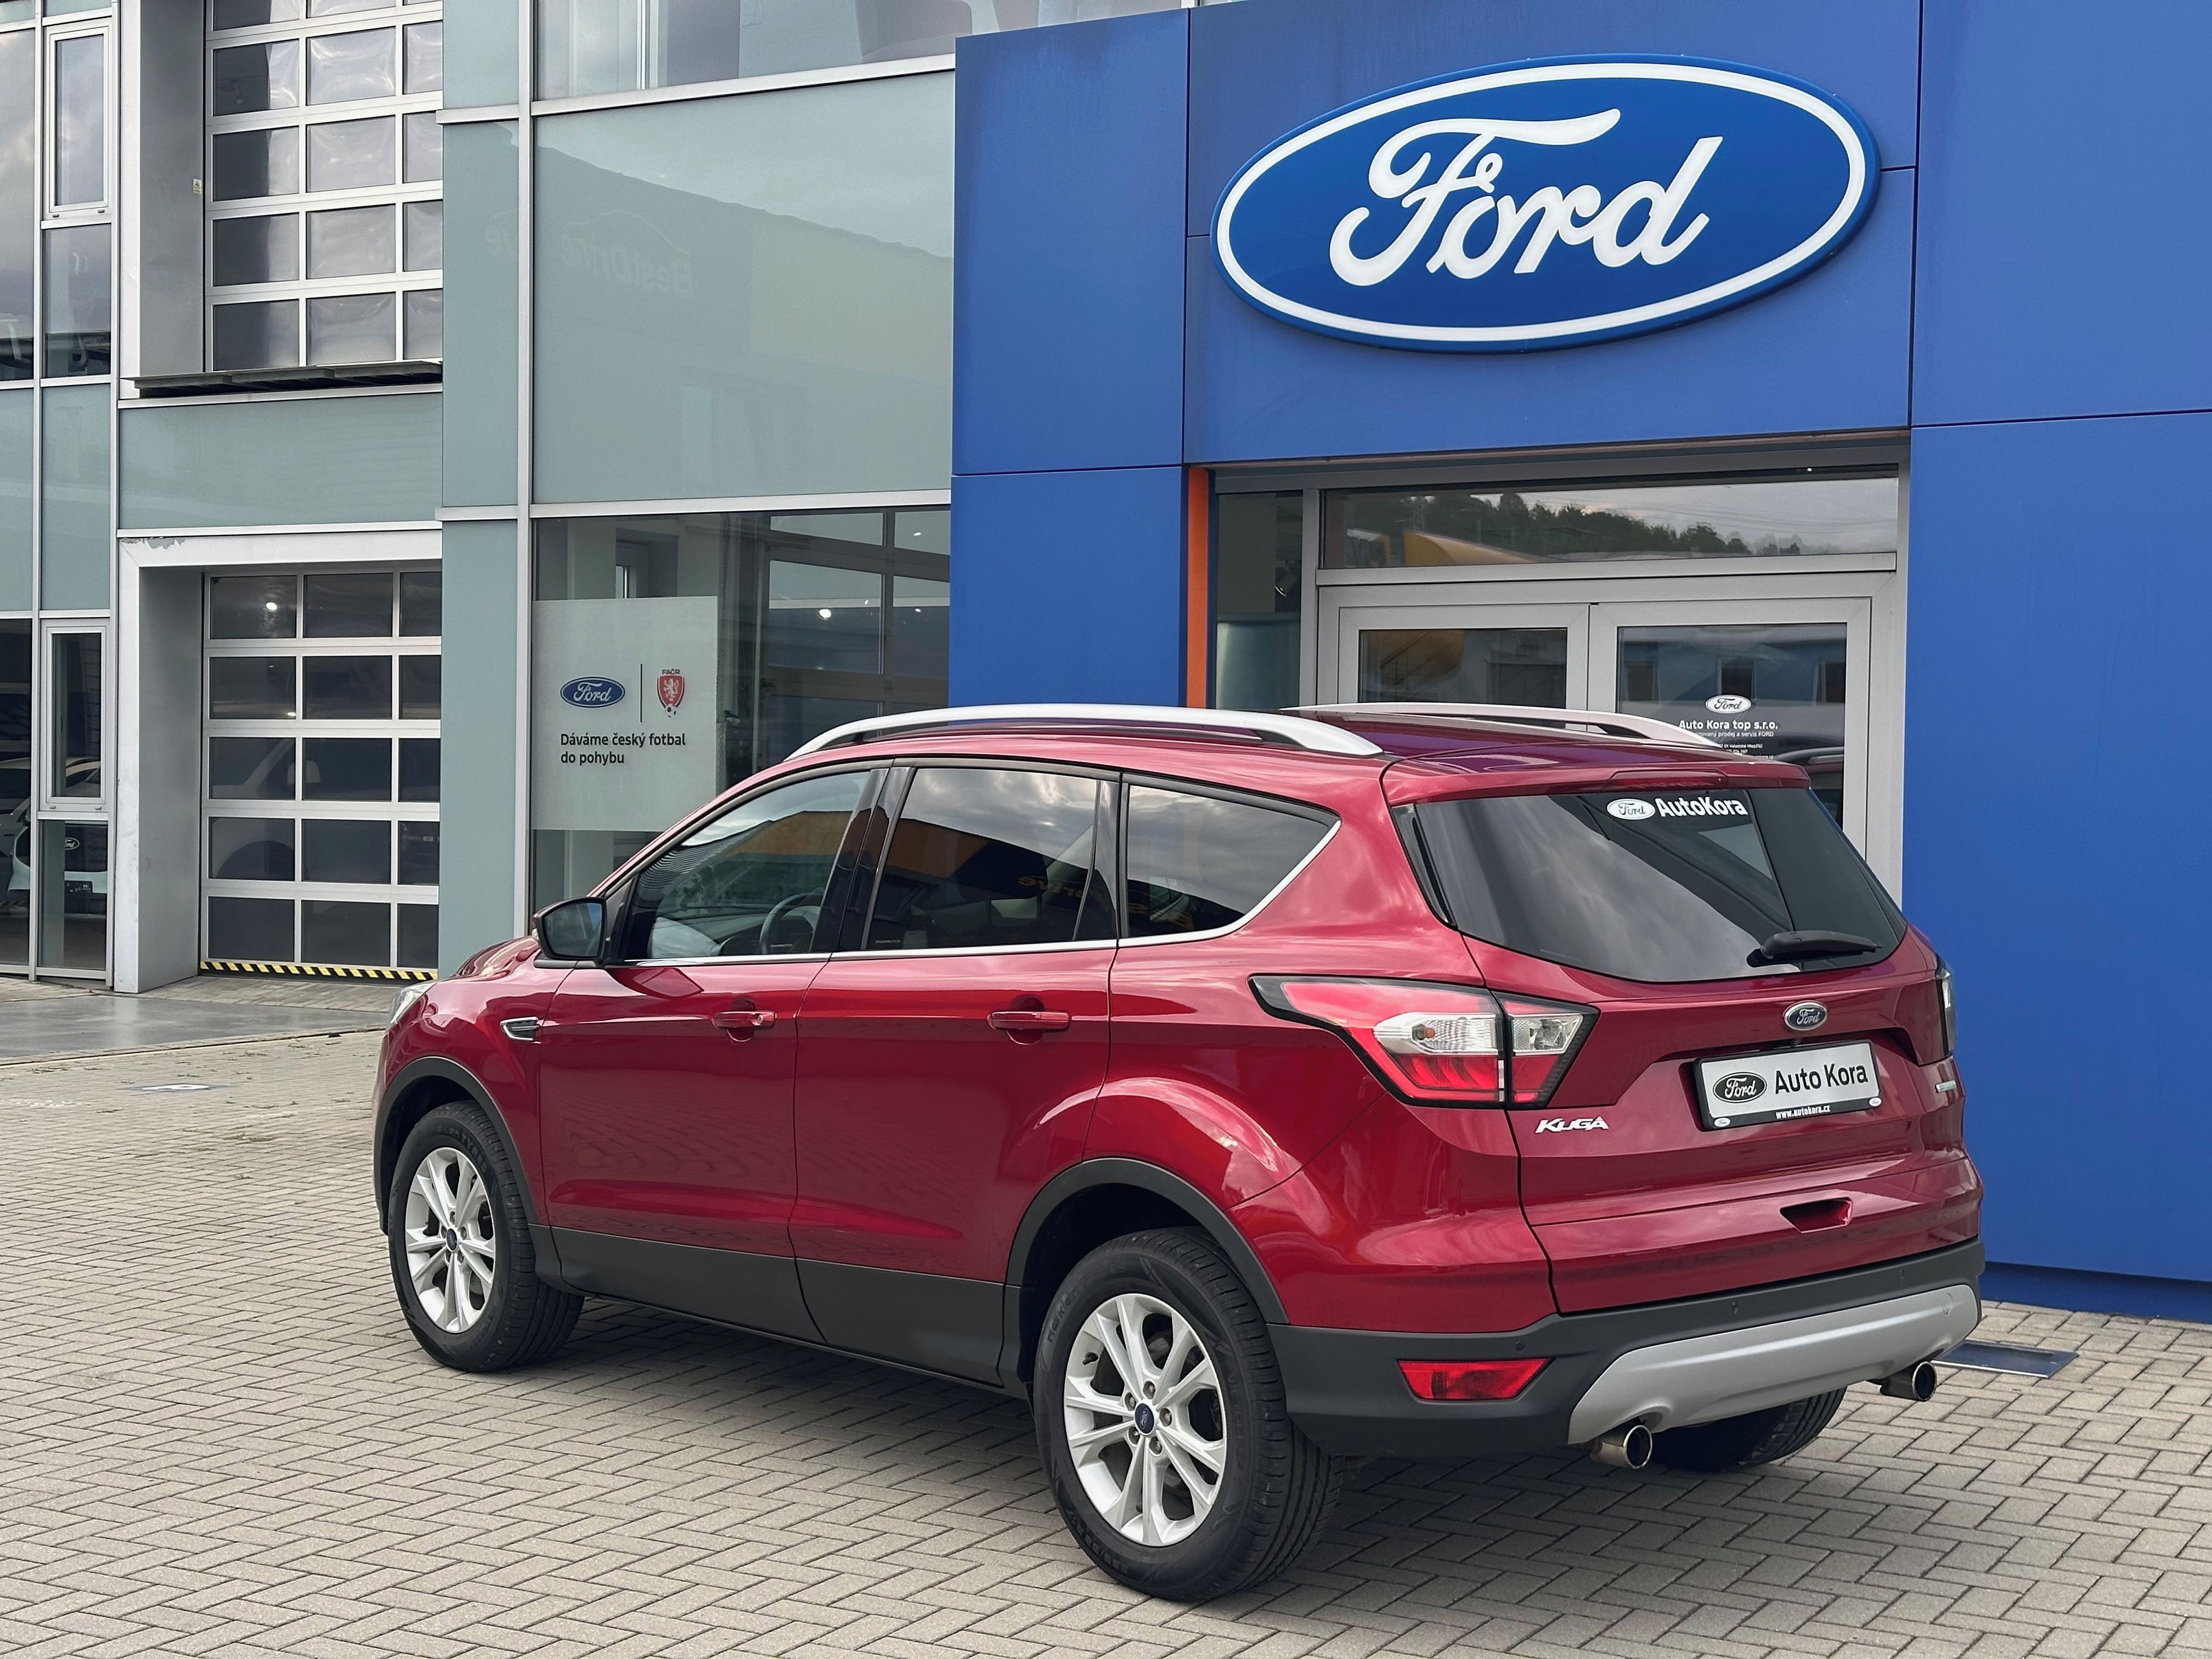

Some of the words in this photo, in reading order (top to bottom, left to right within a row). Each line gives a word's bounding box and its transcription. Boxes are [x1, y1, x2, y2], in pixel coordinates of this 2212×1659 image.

[1330, 109, 1723, 286] Ford
[573, 682, 612, 702] Ford
[1714, 698, 1742, 709] Ford
[1679, 720, 1703, 730] Auto
[1707, 720, 1729, 730] Kora
[1733, 720, 1751, 731] top
[1754, 721, 1778, 730] s.r.o.
[561, 732, 608, 746] Dáváme
[612, 732, 646, 748] český
[649, 733, 686, 746] fotbal
[561, 751, 575, 764] do
[579, 751, 624, 766] pohybu
[1618, 803, 1646, 815] Ford
[1655, 797, 1748, 817] AutoKora
[1797, 1008, 1820, 1024] Ford
[1725, 1077, 1757, 1098] Ford
[1775, 1068, 1821, 1094] Auto
[1824, 1063, 1869, 1087] Kora
[1775, 1105, 1831, 1120] www.autokora.cz
[1535, 1116, 1610, 1134] KUGA
